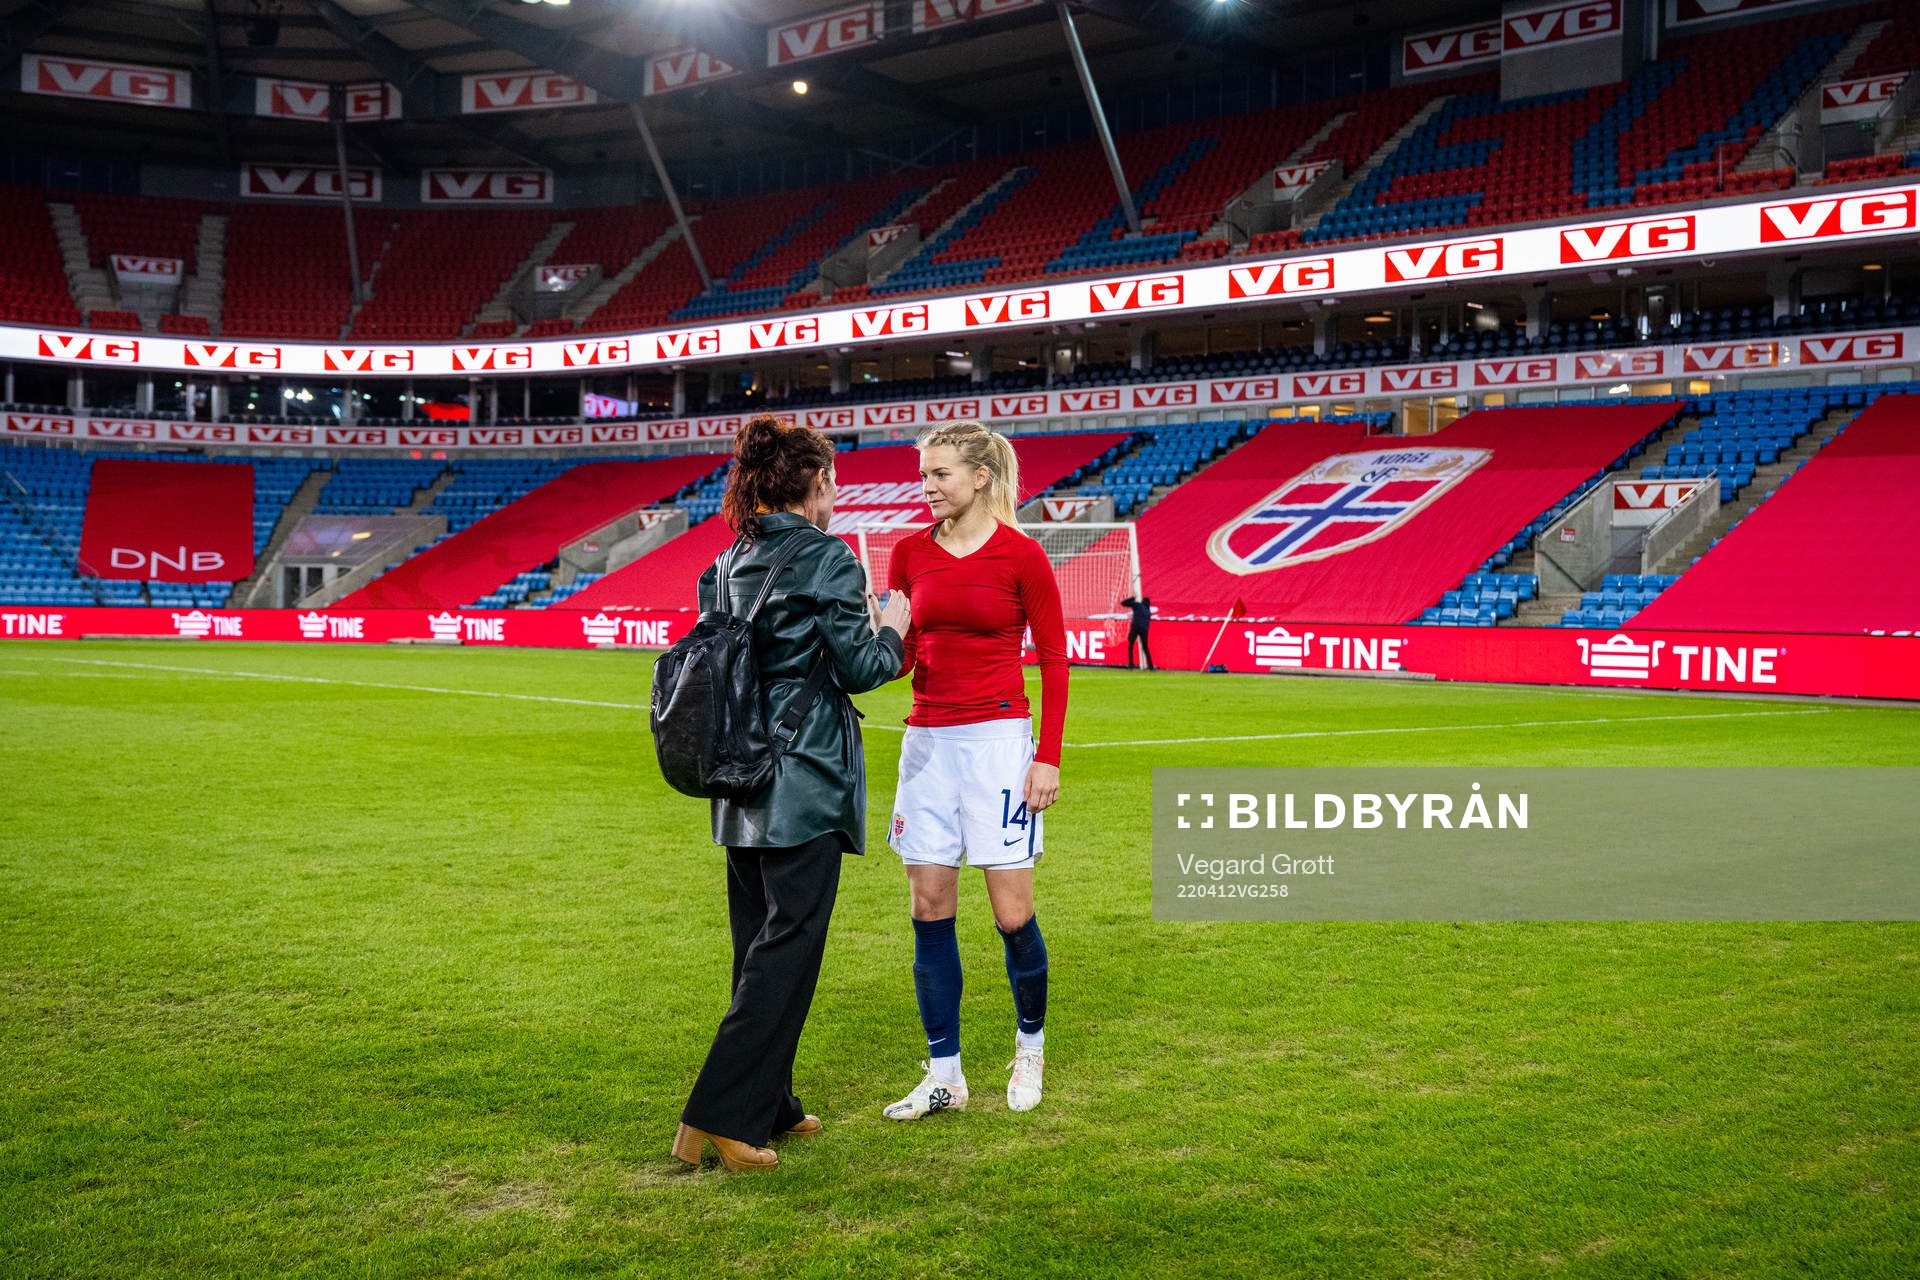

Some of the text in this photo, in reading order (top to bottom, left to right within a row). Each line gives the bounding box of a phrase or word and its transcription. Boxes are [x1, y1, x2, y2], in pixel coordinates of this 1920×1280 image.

[779, 12, 869, 57] VG
[1509, 4, 1613, 43] VG
[1409, 28, 1500, 65] VG
[42, 62, 171, 101] VG
[476, 74, 583, 108] VG
[253, 168, 367, 197] VG
[431, 173, 546, 199] VG
[40, 192, 1911, 371] VG VG VG VG VG VG VG VG VG VG VG VG VG VG
[117, 257, 177, 275] VG
[7, 416, 74, 435] VG
[89, 421, 155, 439] VG
[170, 424, 234, 441] VG
[250, 427, 312, 443] VG
[327, 430, 386, 444] VG
[400, 430, 457, 446] VG
[470, 430, 522, 445] VG
[535, 428, 582, 443] VG
[593, 426, 637, 442] VG
[649, 423, 688, 440] VG
[698, 419, 741, 436] VG
[807, 410, 853, 428] VG
[865, 406, 914, 425] VG
[928, 401, 979, 421] VG
[992, 396, 1047, 417] VG
[1062, 391, 1120, 412] VG
[1135, 385, 1196, 407] VG
[1212, 380, 1278, 402] VG
[1294, 373, 1364, 397] VG
[1382, 366, 1457, 391] VG
[1476, 359, 1556, 386] VG
[1577, 352, 1662, 379] VG
[1685, 343, 1778, 371] VG
[1804, 334, 1899, 363] VG
[1371, 452, 1433, 466] NORGE
[111, 546, 225, 578] DNB
[2, 614, 63, 635] TINE
[213, 616, 243, 637] TINE
[329, 617, 364, 638] TINE
[464, 617, 504, 641] TINE
[624, 620, 669, 645] TINE
[1065, 630, 1105, 660] NE
[1319, 636, 1402, 671] TINE
[1673, 645, 1778, 684] TINE
[1001, 788, 1028, 831] 14
